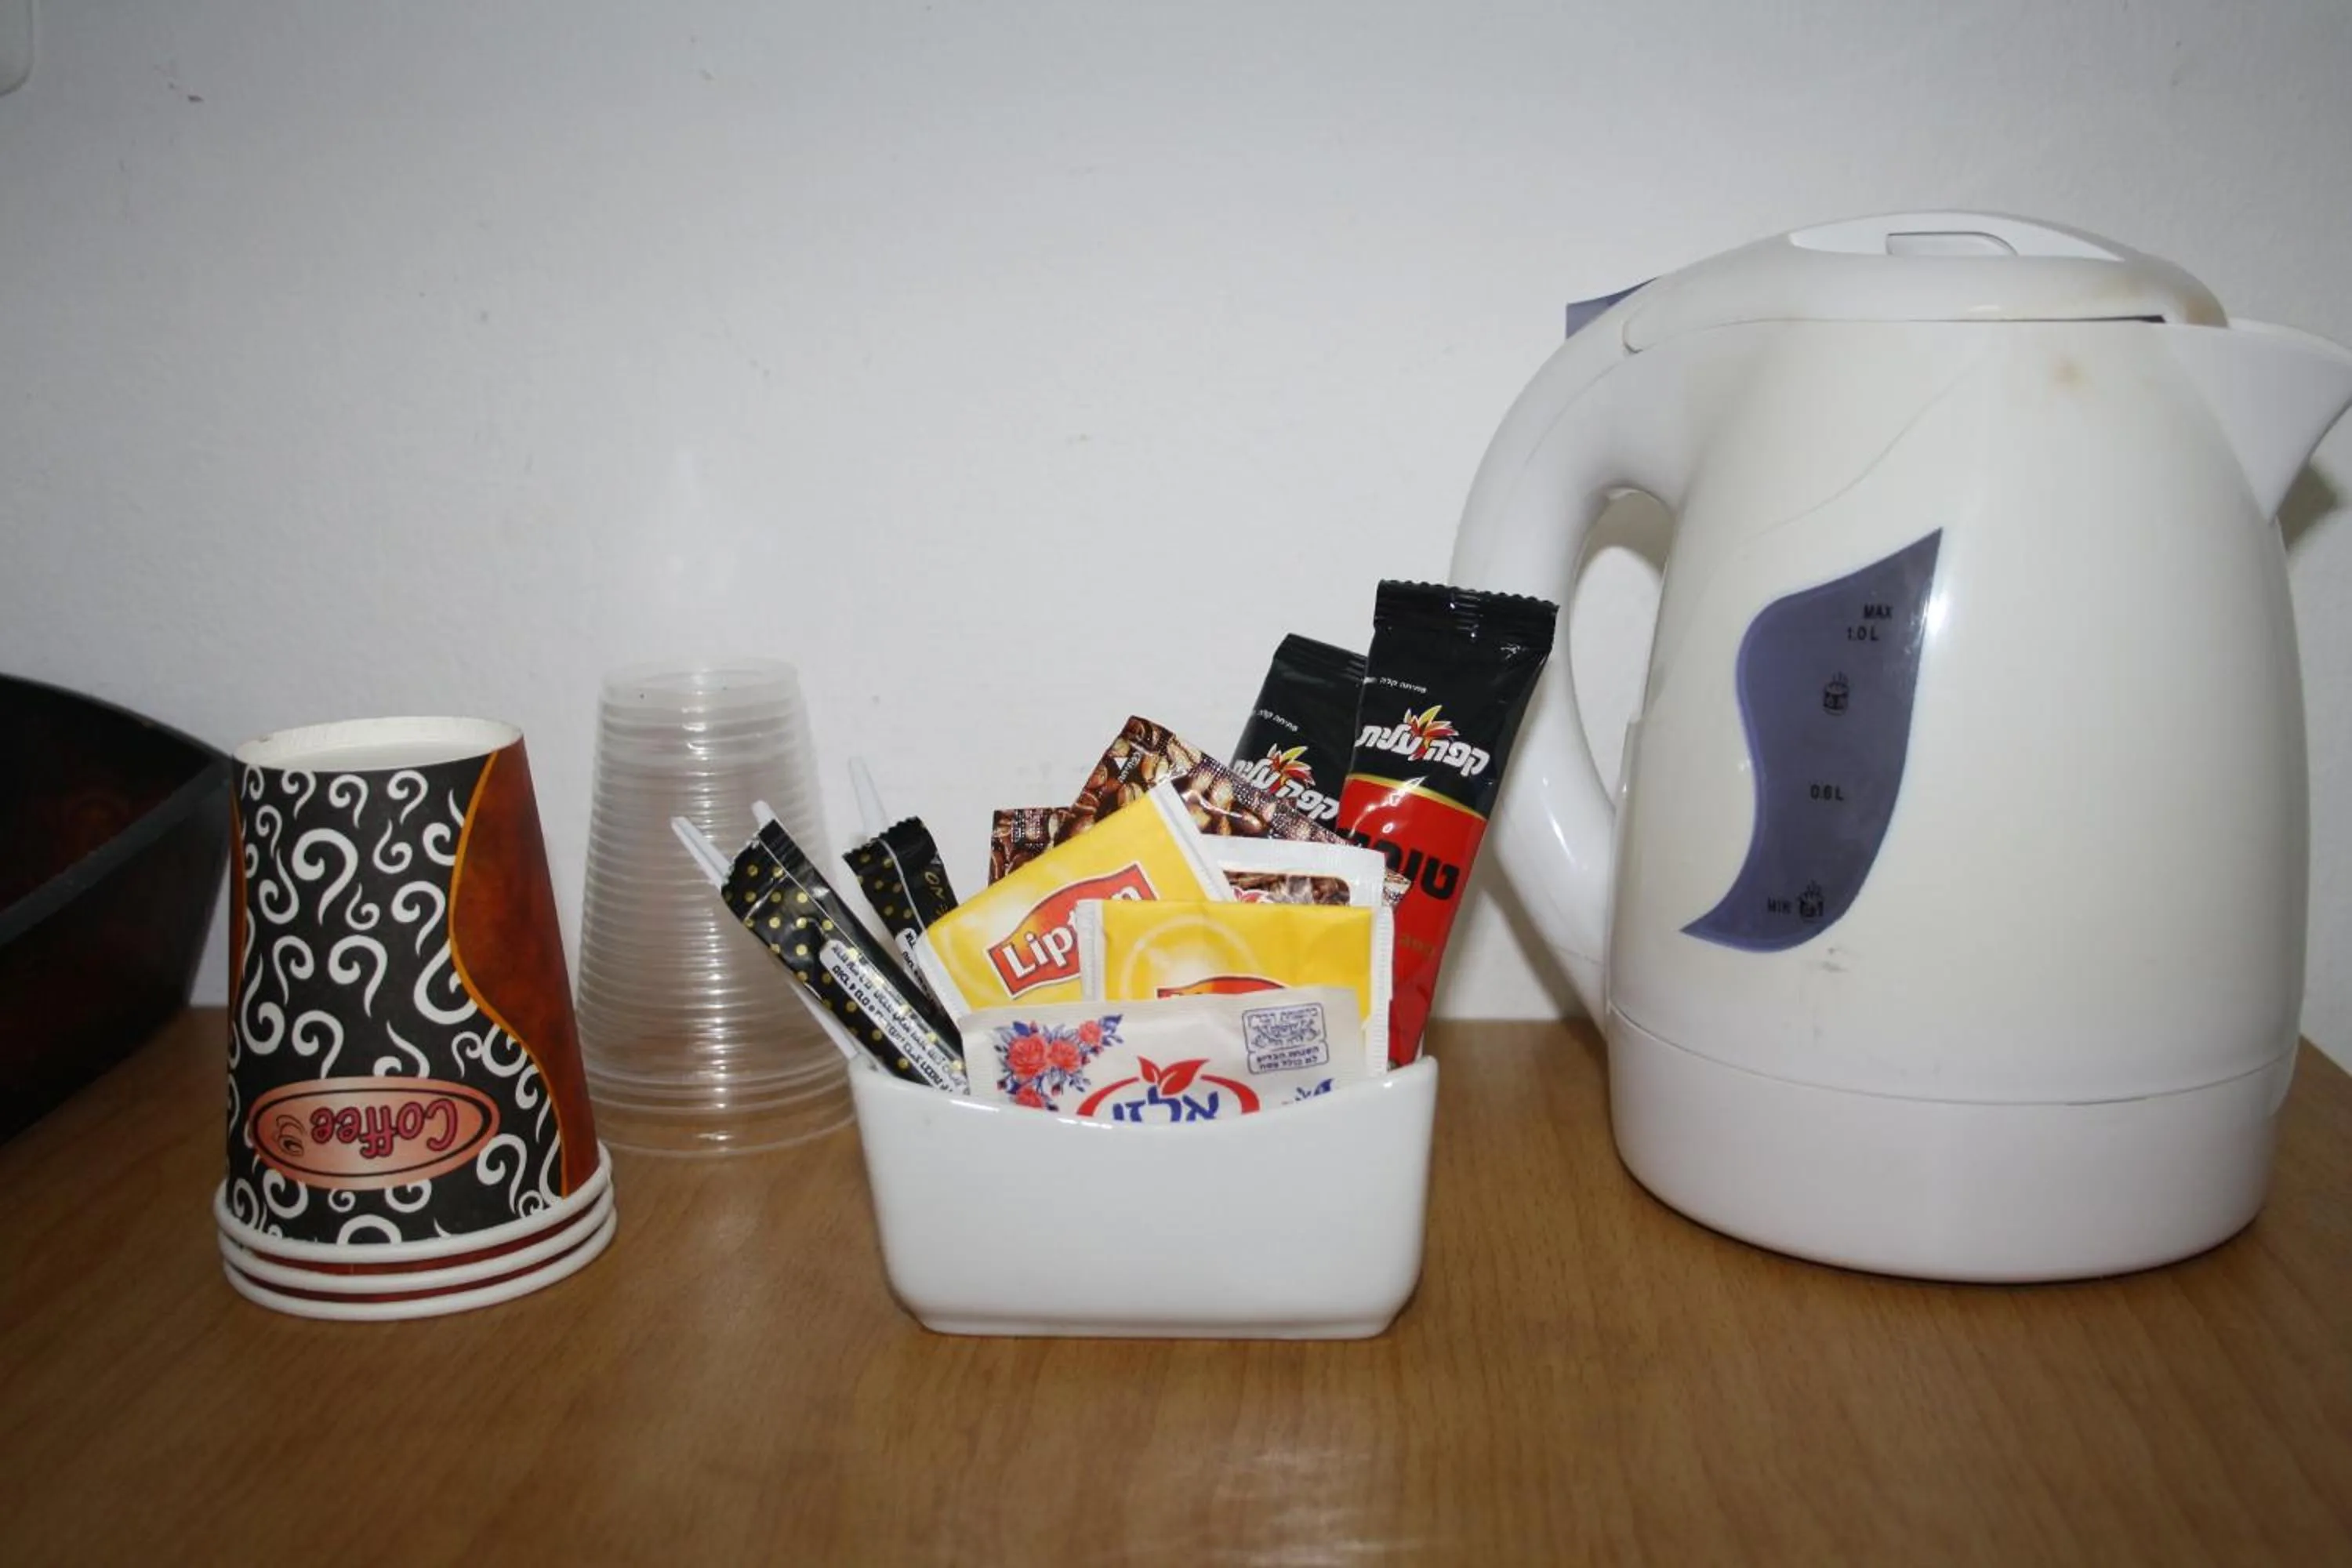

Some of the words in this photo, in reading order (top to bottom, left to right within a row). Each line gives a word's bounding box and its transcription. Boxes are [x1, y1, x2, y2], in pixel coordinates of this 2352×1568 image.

[1863, 604, 1894, 619] MAX
[1870, 626, 1879, 641] L
[1354, 724, 1424, 761] עלית
[1423, 738, 1491, 777] קפה
[1276, 779, 1340, 820] קפה
[1835, 786, 1845, 801] L
[309, 1098, 459, 1160] Coffee
